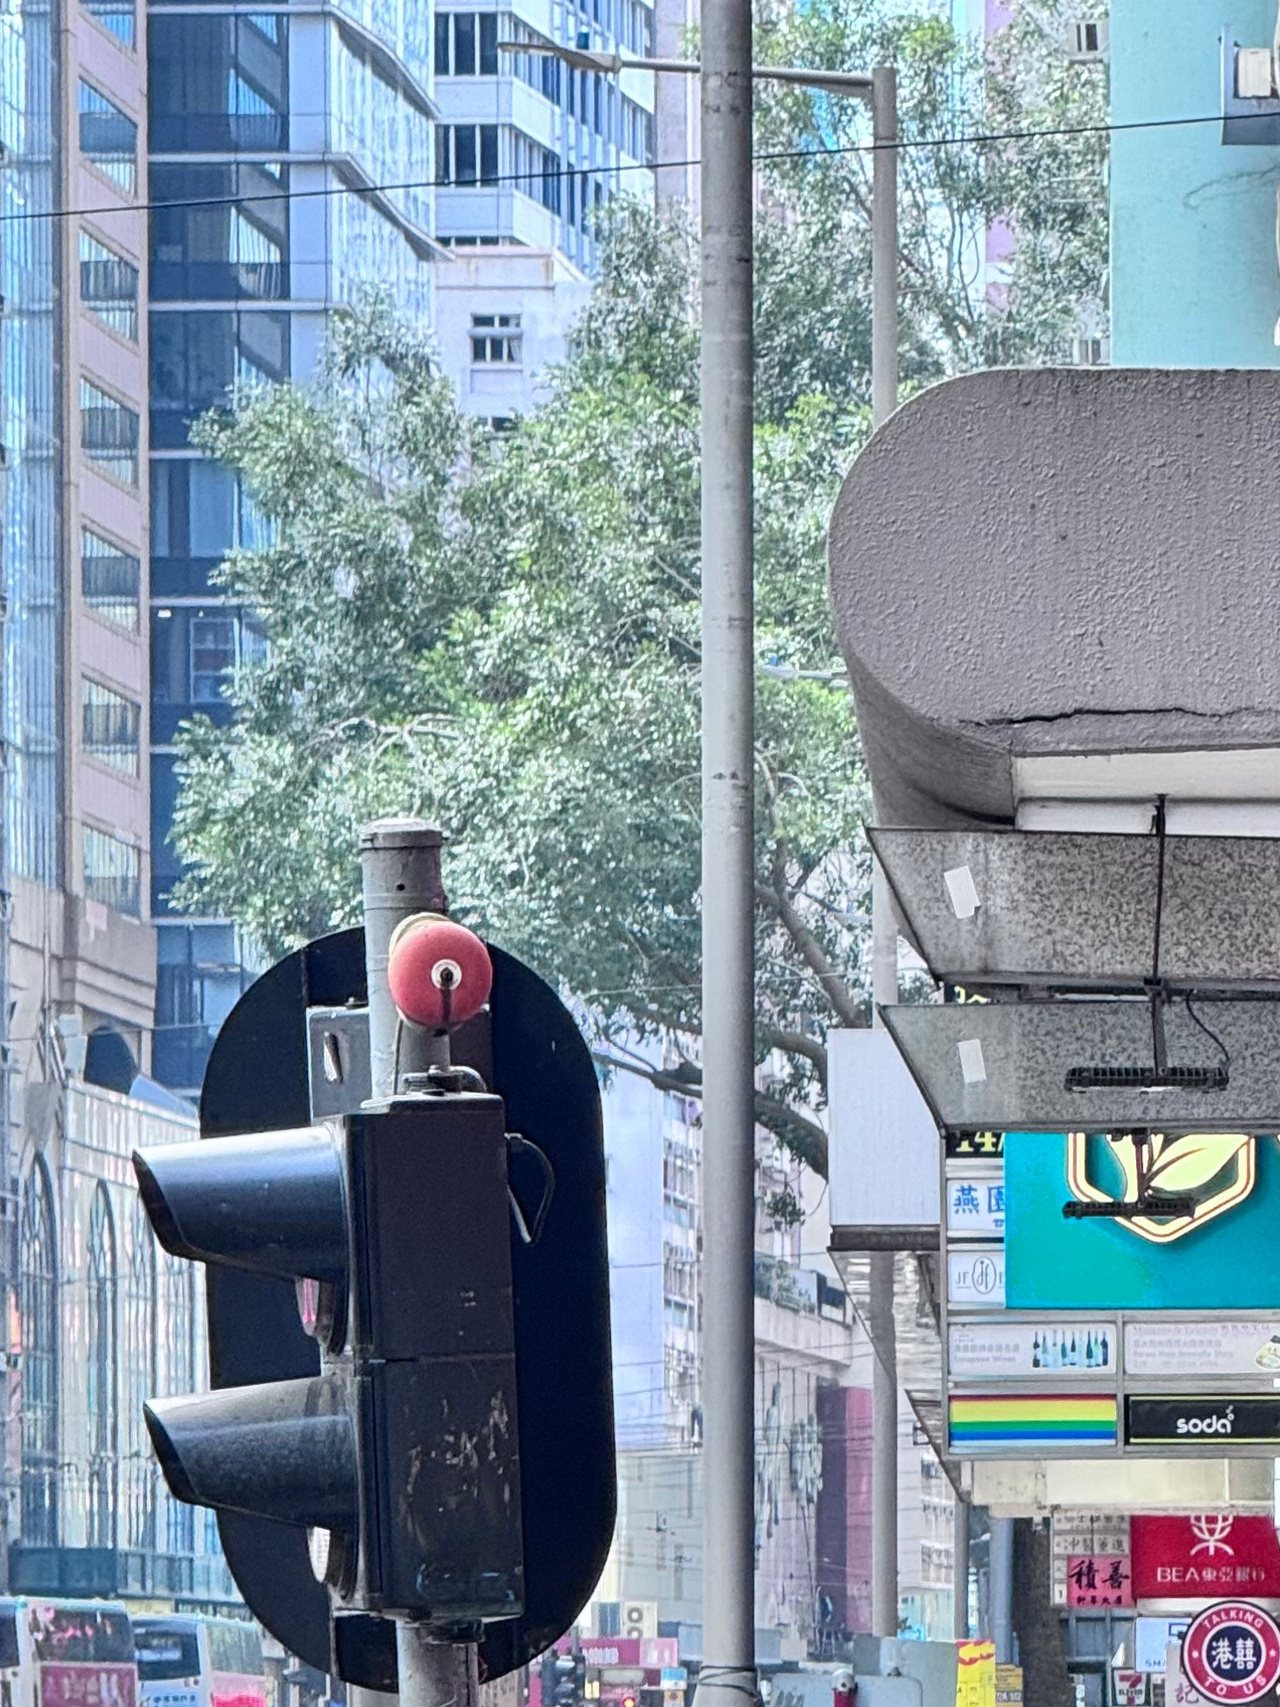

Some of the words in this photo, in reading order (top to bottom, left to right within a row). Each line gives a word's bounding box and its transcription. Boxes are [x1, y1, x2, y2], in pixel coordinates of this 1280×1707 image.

[1176, 1414, 1233, 1434] soda
[1157, 1566, 1199, 1582] BEA
[1203, 1610, 1265, 1630] TALKING
[1205, 1676, 1229, 1696] TO
[1243, 1675, 1267, 1694] US
